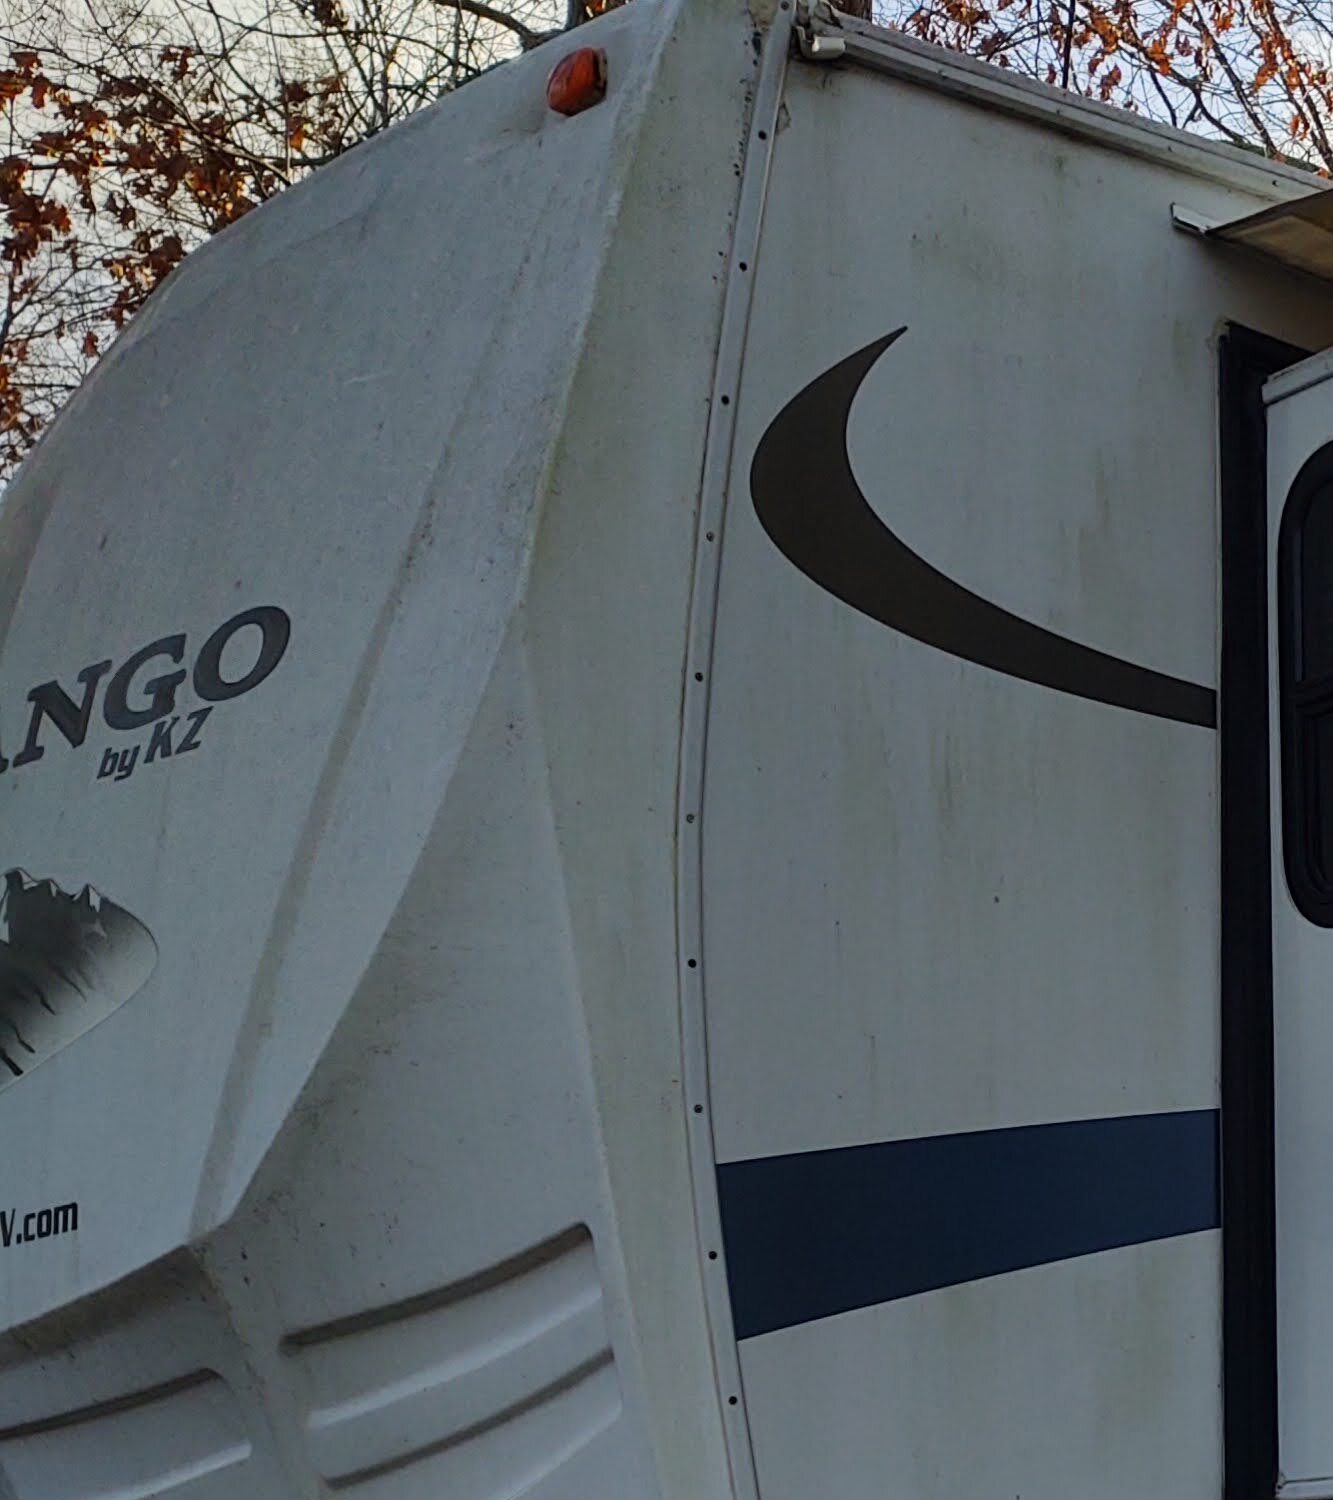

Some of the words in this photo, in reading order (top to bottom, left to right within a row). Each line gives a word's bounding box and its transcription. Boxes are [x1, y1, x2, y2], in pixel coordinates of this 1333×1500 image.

[0, 606, 291, 774] NGO
[97, 745, 140, 781] by
[143, 705, 214, 764] KZ
